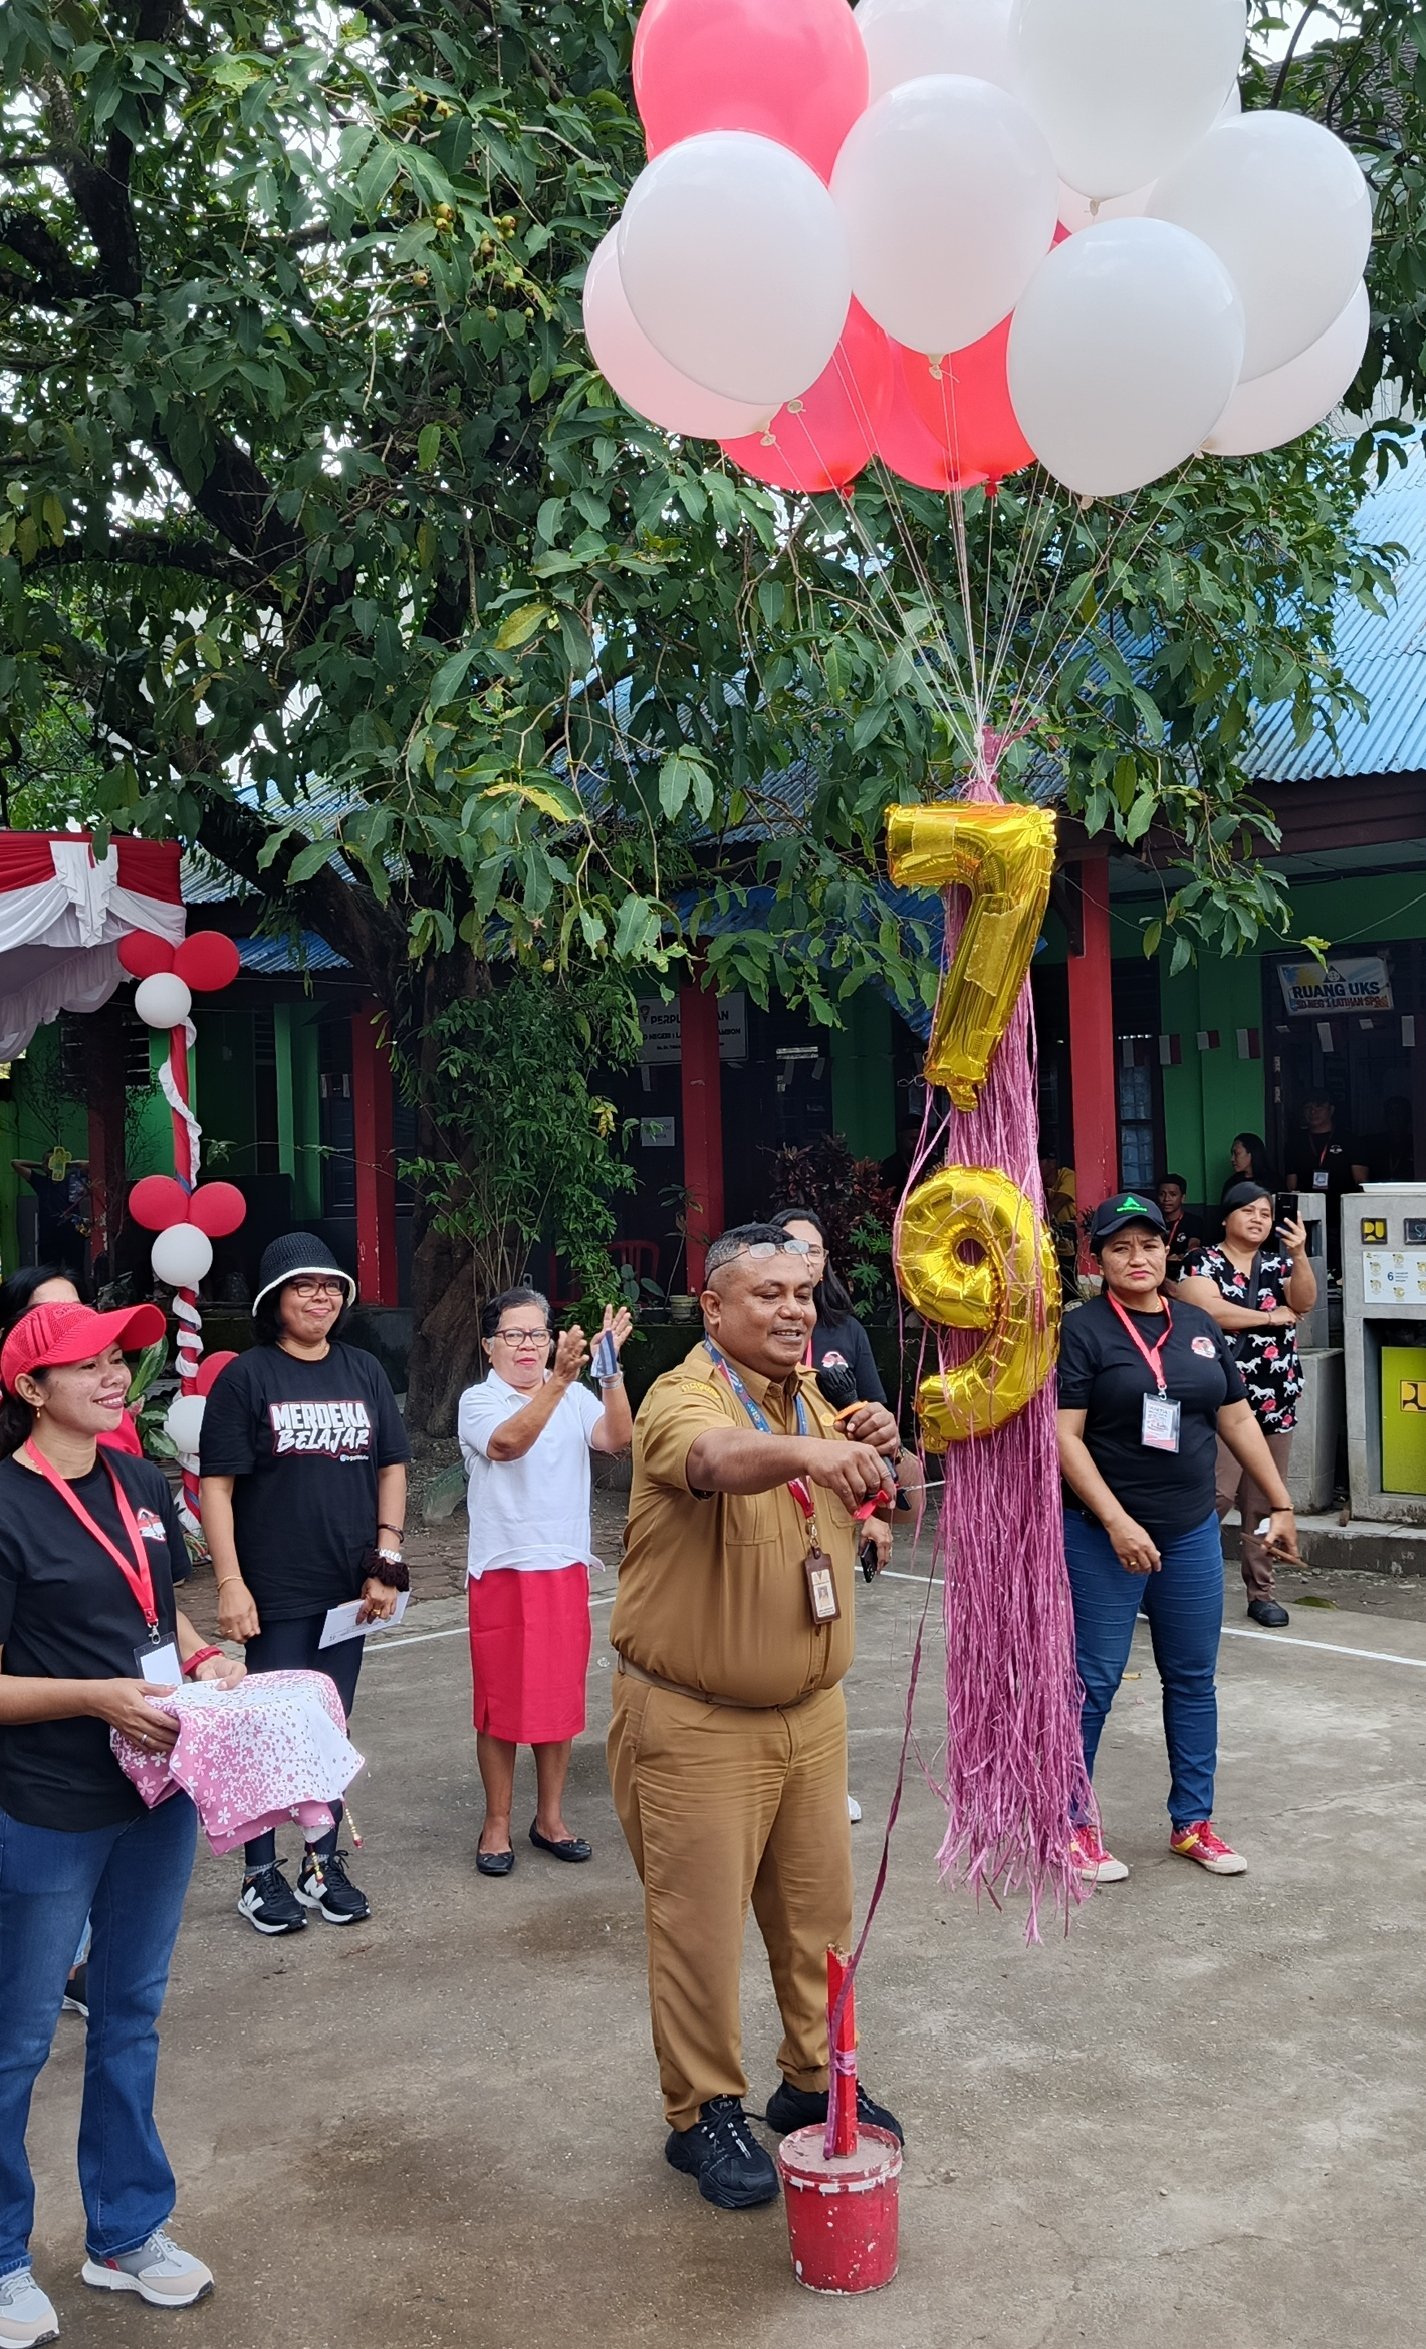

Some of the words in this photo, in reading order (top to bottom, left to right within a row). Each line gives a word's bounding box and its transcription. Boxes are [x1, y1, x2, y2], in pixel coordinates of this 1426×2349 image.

[885, 802, 1057, 1110] 7
[1293, 984, 1346, 999] RUANG
[1349, 981, 1381, 996] UKS
[1387, 1271, 1394, 1281] 6
[897, 1164, 1062, 1452] 9
[270, 1402, 371, 1431] MERDEKA
[276, 1426, 370, 1453] BELAJAR
